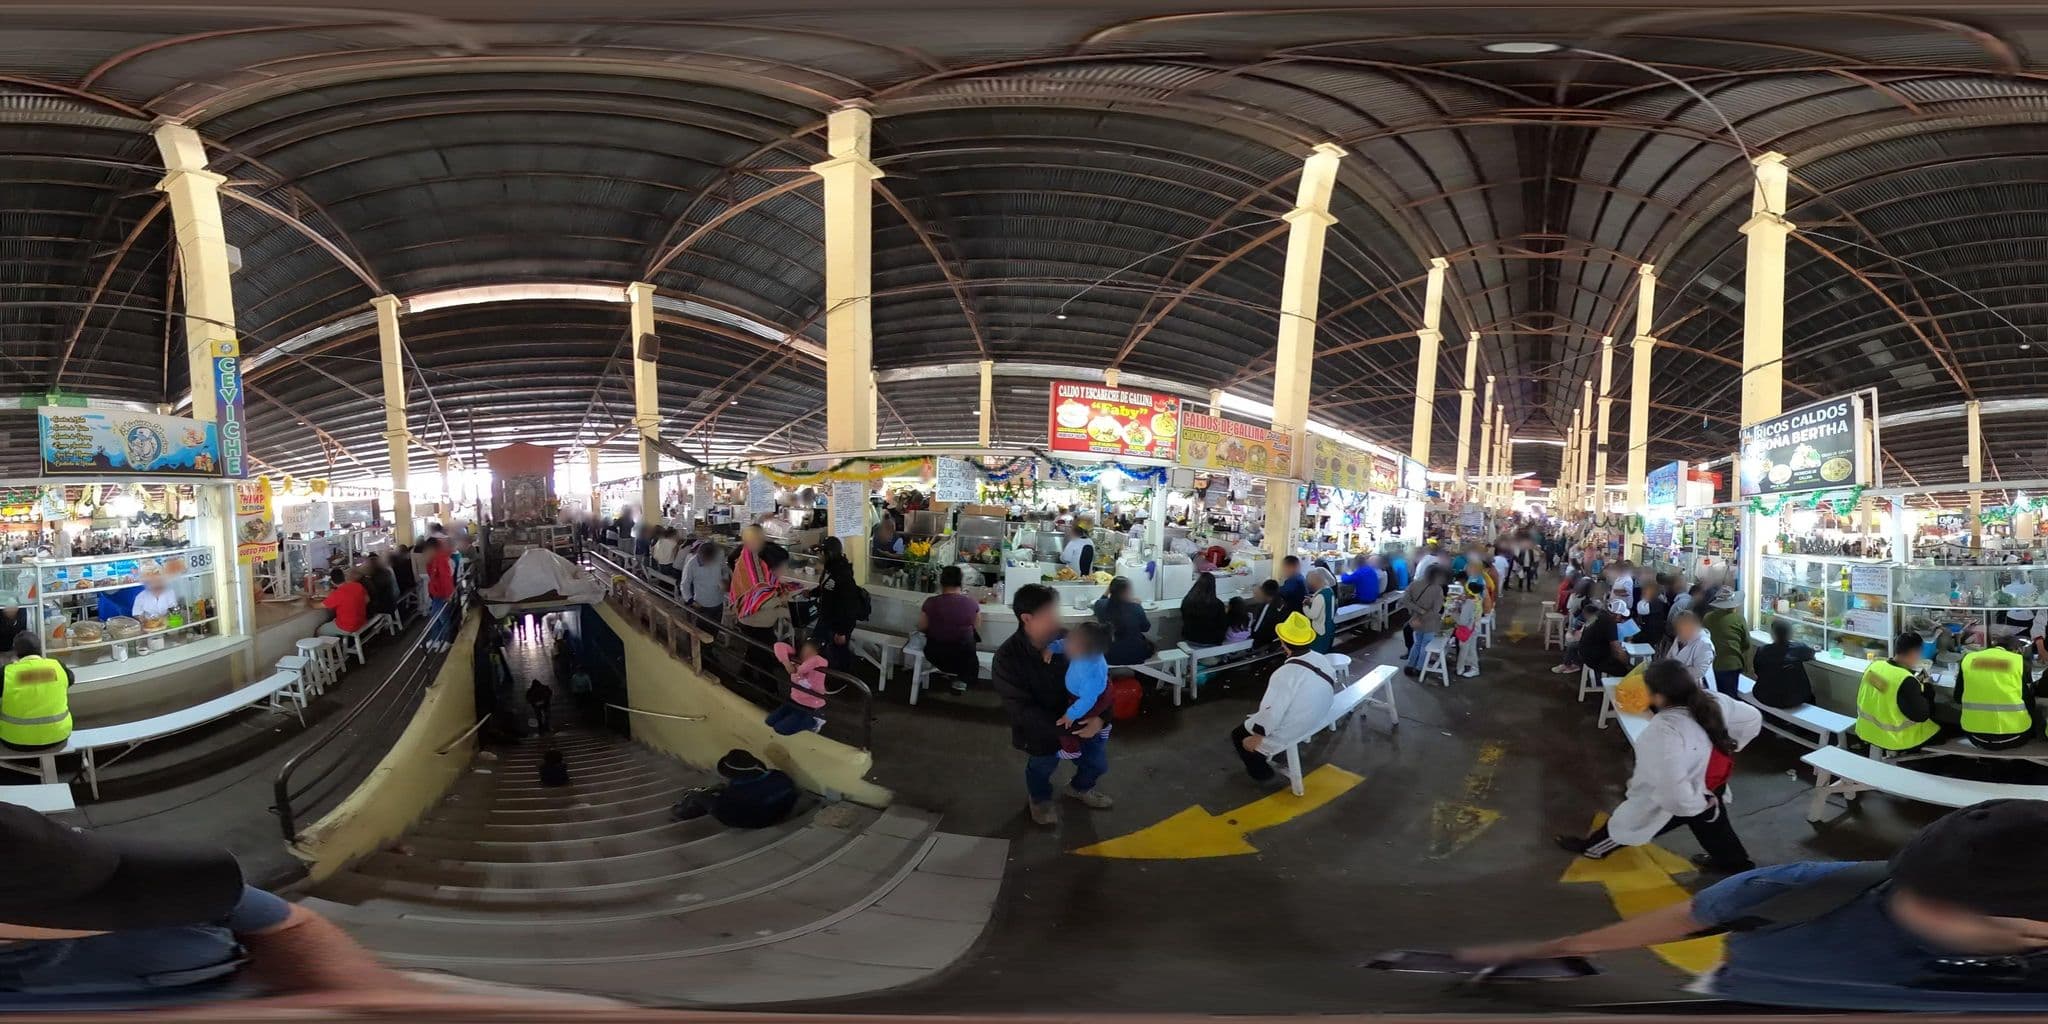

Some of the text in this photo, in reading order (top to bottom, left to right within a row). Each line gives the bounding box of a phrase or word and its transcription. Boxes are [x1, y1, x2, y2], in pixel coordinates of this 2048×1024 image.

[1059, 385, 1080, 398] CALDO
[1086, 387, 1120, 402] ESCABECHE
[1120, 390, 1129, 403] DE
[1129, 392, 1153, 407] GALLINA
[218, 357, 242, 475] CEVICHE
[1183, 412, 1265, 442] CALDOS DE GALLINA
[1756, 403, 1848, 440] RICOS CALDOS
[1792, 420, 1849, 444] BERTHA
[240, 495, 265, 505] THIMP
[191, 554, 212, 567] 889
